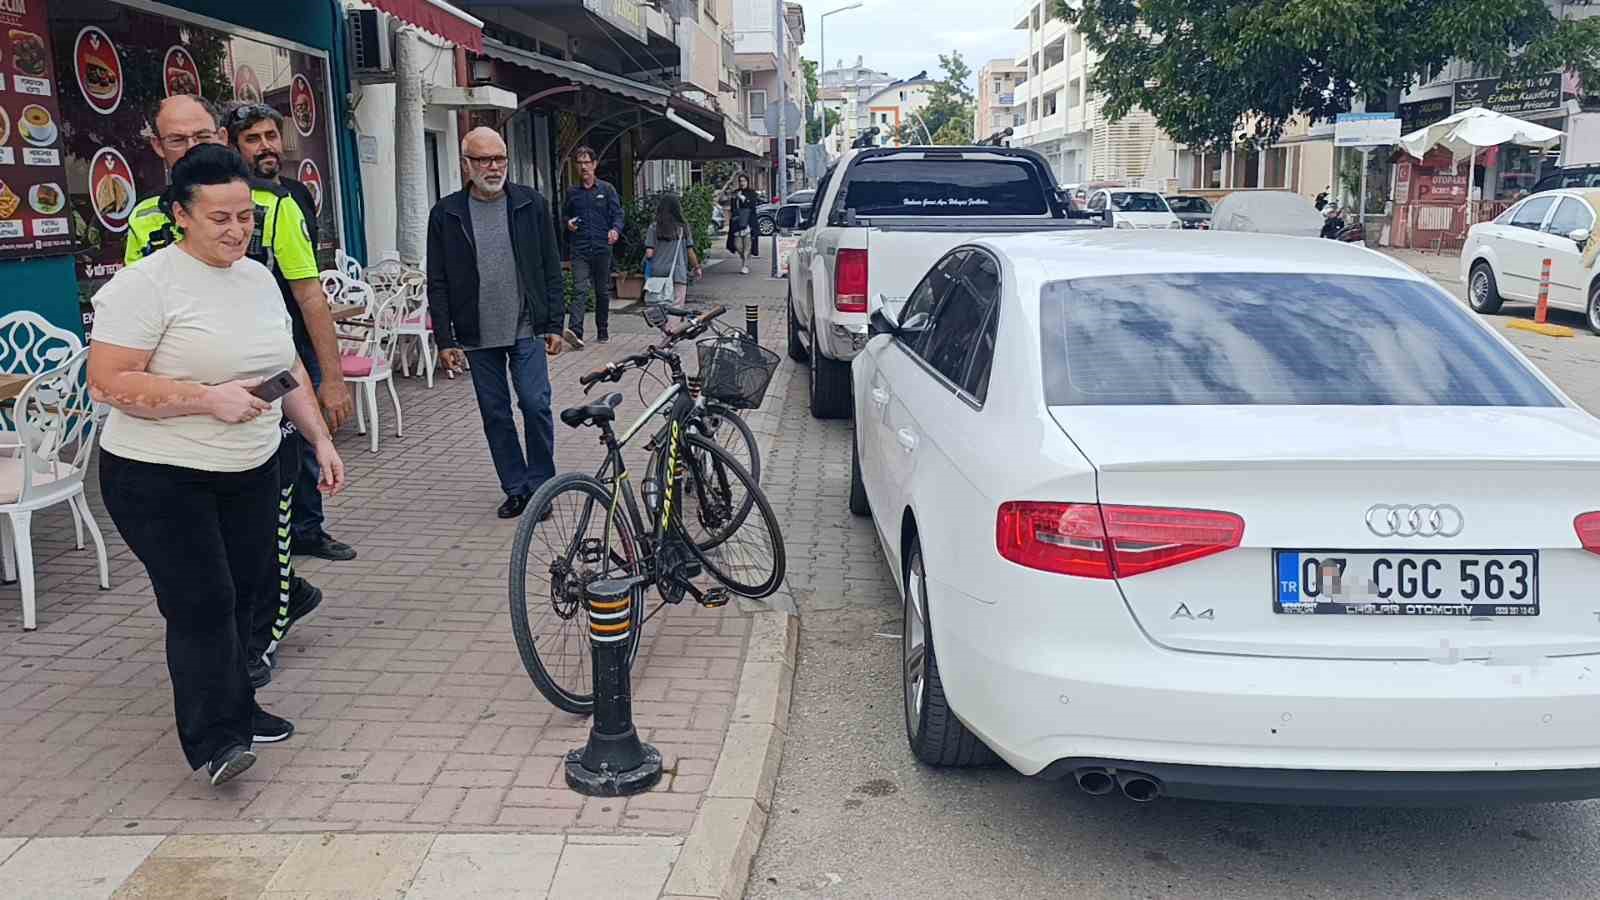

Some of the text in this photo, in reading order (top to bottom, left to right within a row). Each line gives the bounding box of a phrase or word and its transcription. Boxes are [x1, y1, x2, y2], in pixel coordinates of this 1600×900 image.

[1280, 580, 1298, 594] TR
[1372, 557, 1442, 600] CGC
[1459, 558, 1529, 602] 563
[1170, 602, 1215, 621] A4
